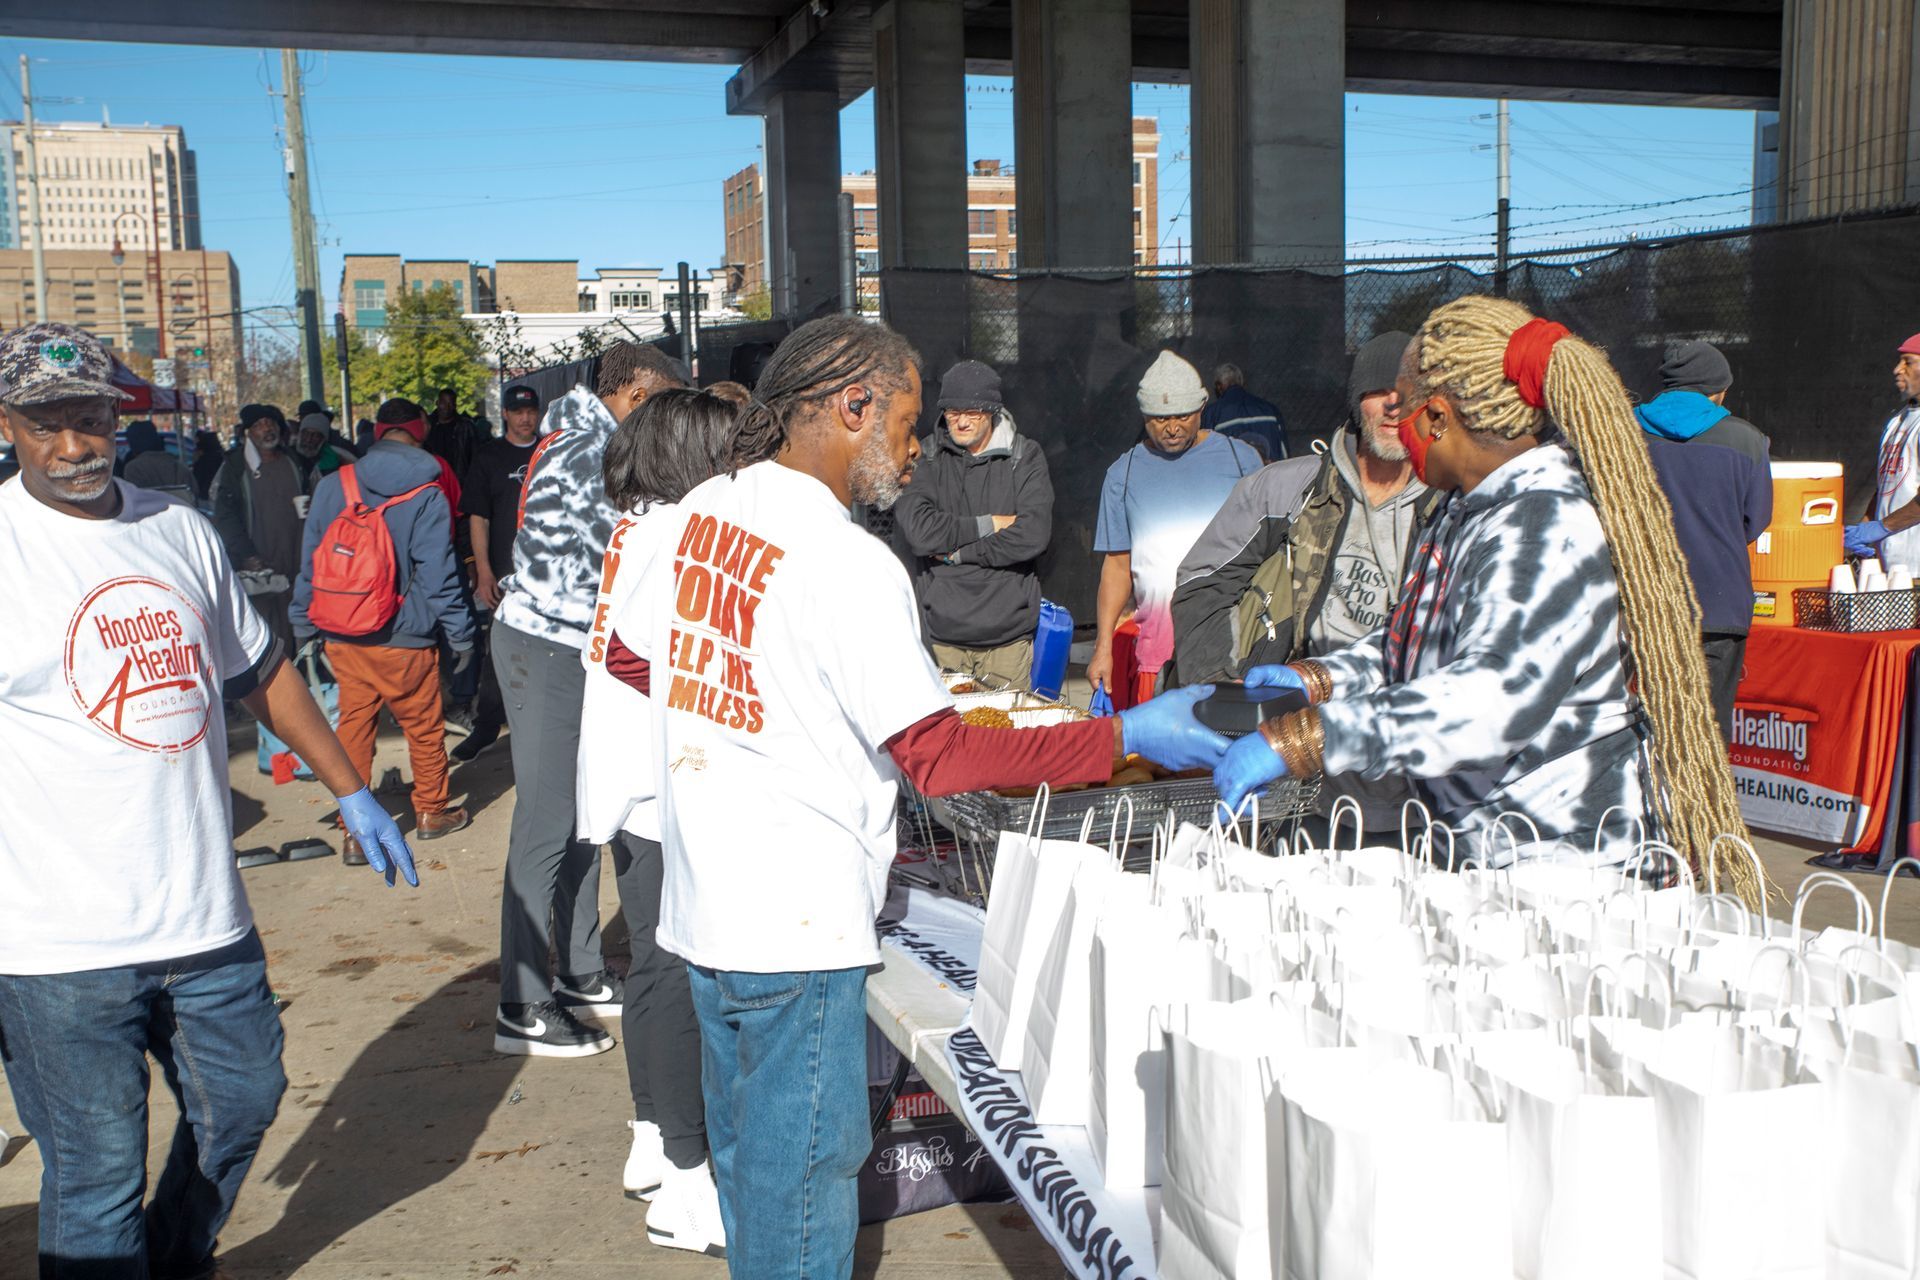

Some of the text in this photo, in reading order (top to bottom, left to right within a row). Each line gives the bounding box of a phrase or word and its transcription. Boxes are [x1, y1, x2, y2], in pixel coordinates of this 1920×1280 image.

[1345, 581, 1376, 605] Pro
[1347, 559, 1388, 588] Bass
[94, 606, 182, 650] Hoodies
[1343, 601, 1385, 627] Shop
[131, 638, 200, 682] Healin
[669, 629, 714, 675] ELP
[668, 674, 764, 734] MELESS
[1731, 707, 1807, 760] Healing
[1728, 752, 1810, 772] FOUNDATION
[1734, 776, 1856, 812] HEALING.com
[950, 1027, 1133, 1280] UNDATION SUNDAY
